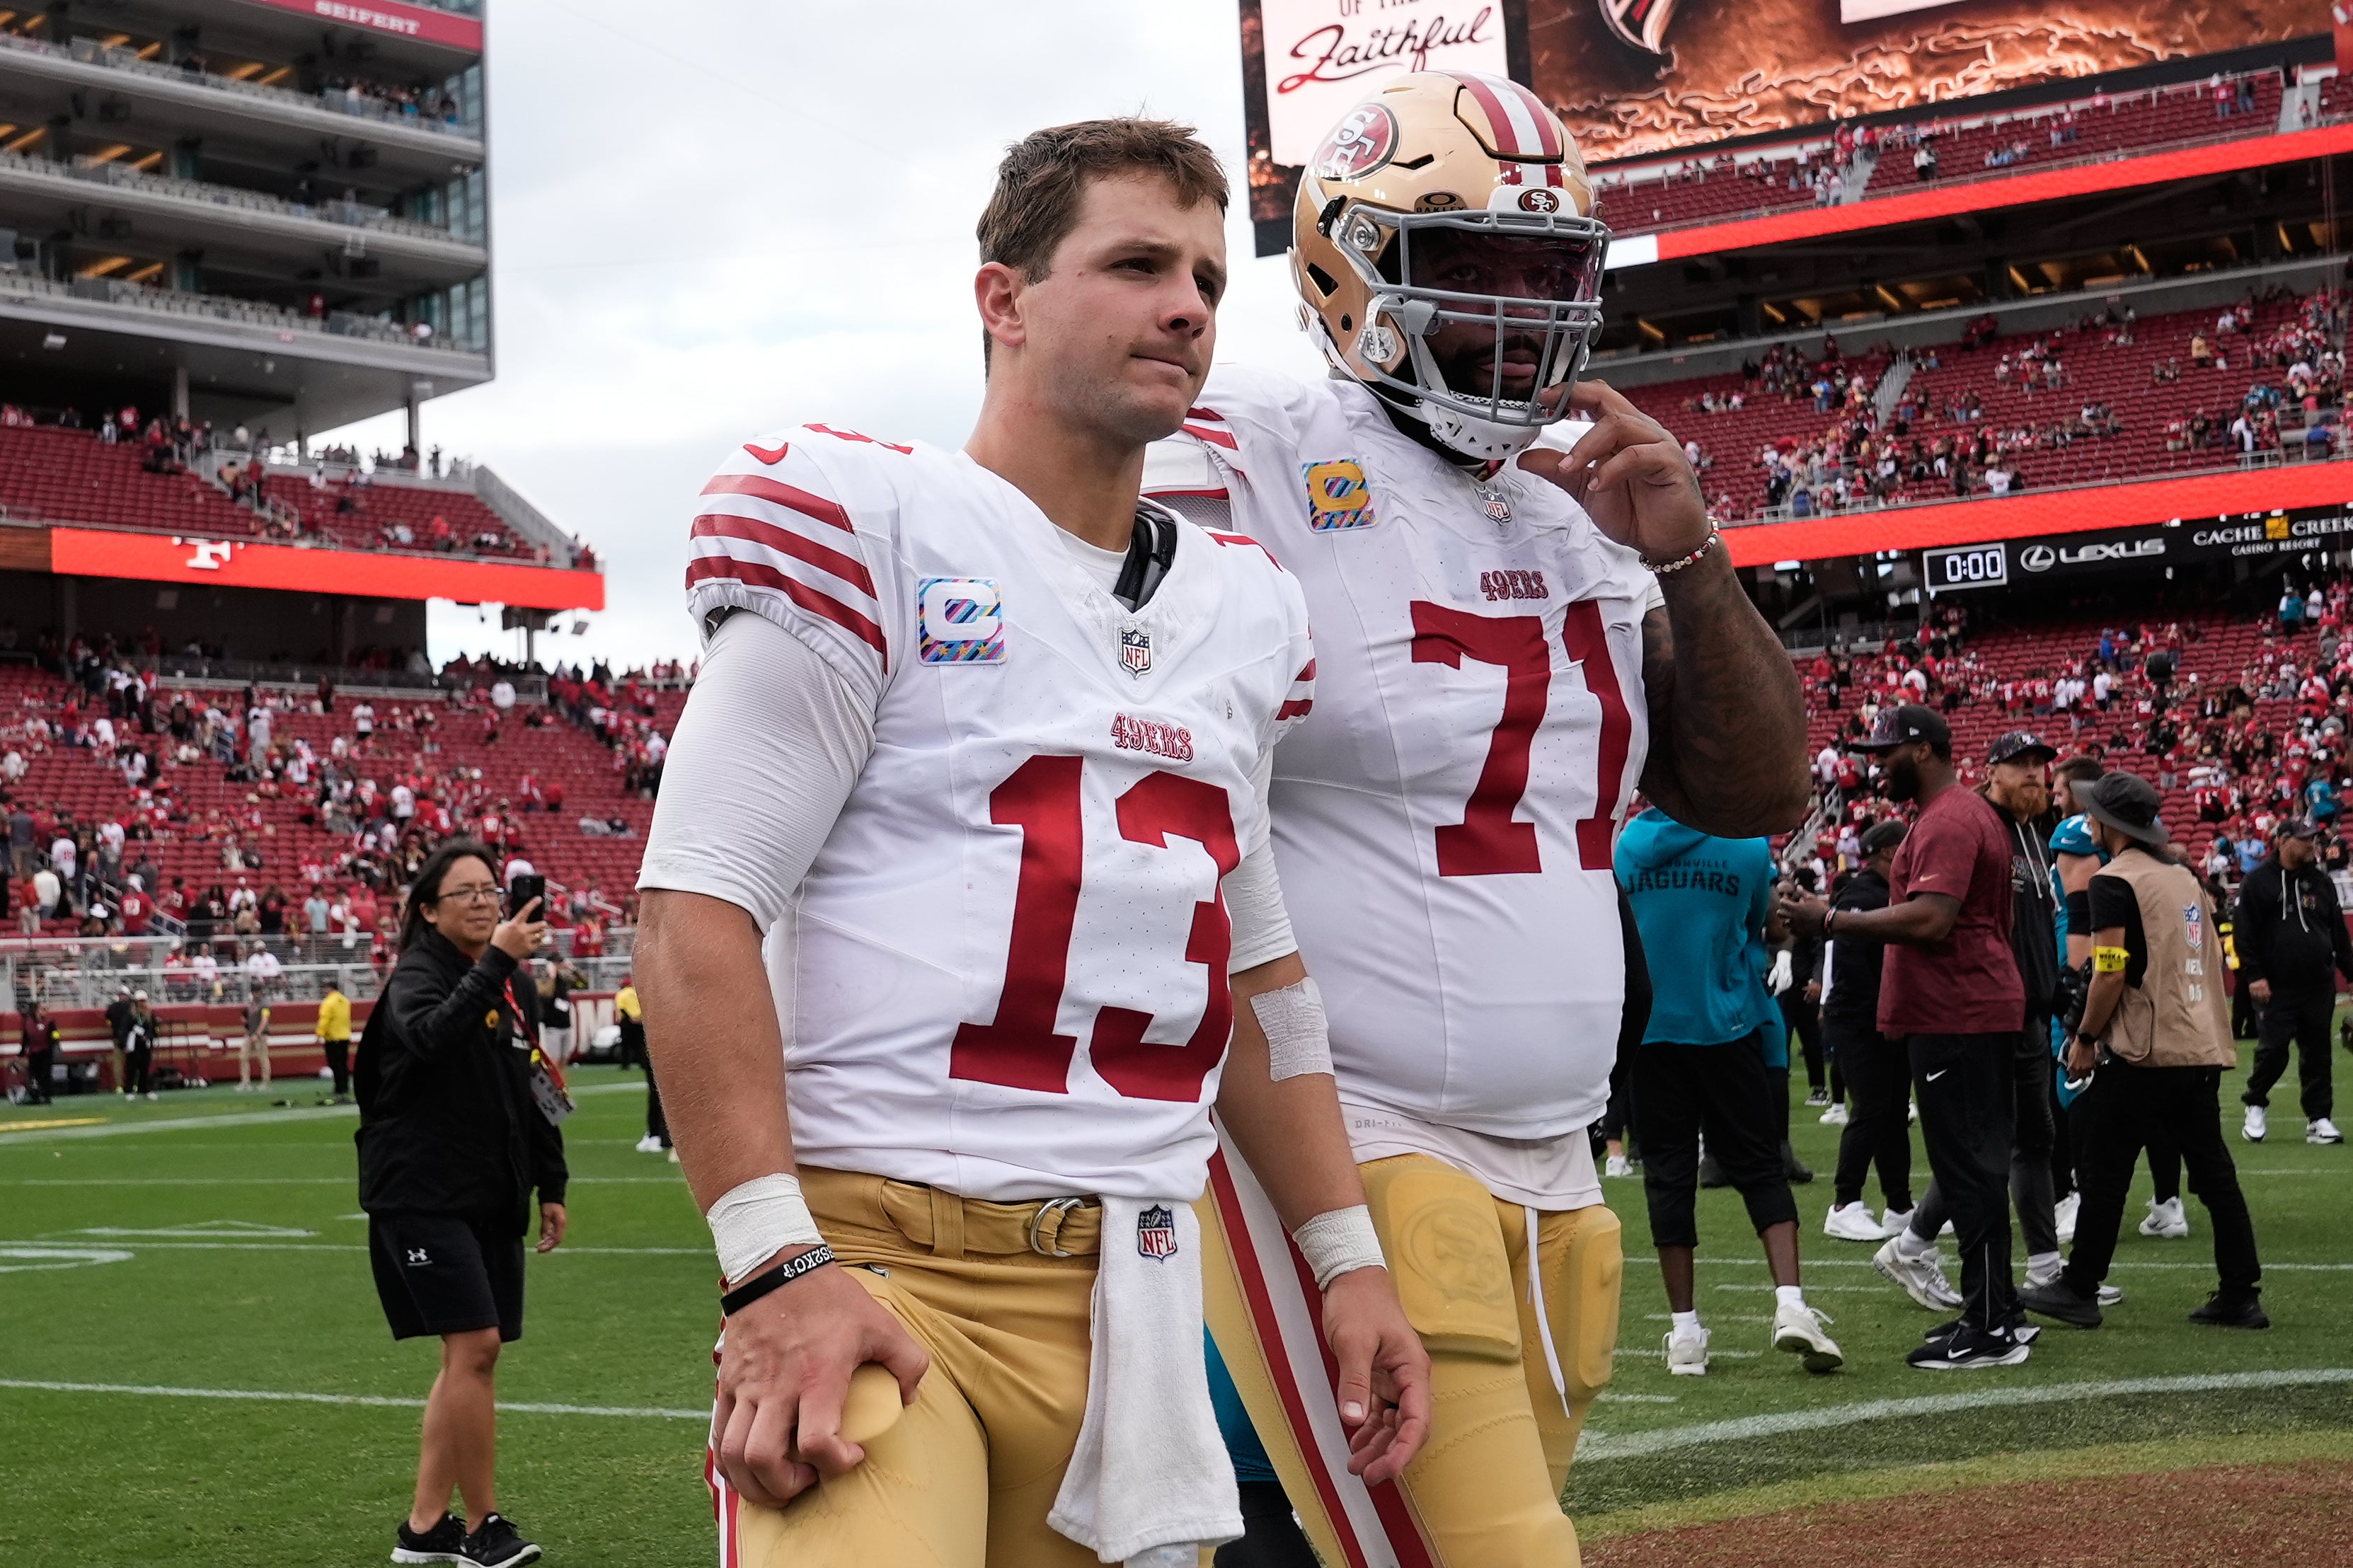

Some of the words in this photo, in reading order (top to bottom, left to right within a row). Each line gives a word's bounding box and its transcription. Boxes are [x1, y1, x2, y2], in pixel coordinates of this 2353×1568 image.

[315, 1, 420, 35] SEIFERT
[1277, 6, 1493, 93] Faithful
[1531, 191, 1554, 212] SF
[1308, 462, 1369, 512] C
[2059, 538, 2165, 563] LEXUS
[2193, 525, 2263, 546] CACHE
[2231, 541, 2274, 556] CASINO
[2279, 536, 2322, 552] RESORT
[1946, 550, 2002, 583] 0:00
[1480, 570, 1548, 601] 49ERS
[924, 582, 999, 640] C
[1125, 646, 1148, 668] NFL
[1110, 712, 1194, 762] 49ERS
[1410, 599, 1632, 877] 71
[1627, 870, 1740, 897] JAGUARS
[950, 754, 1241, 1102] 13
[1141, 1230, 1175, 1255] NFL
